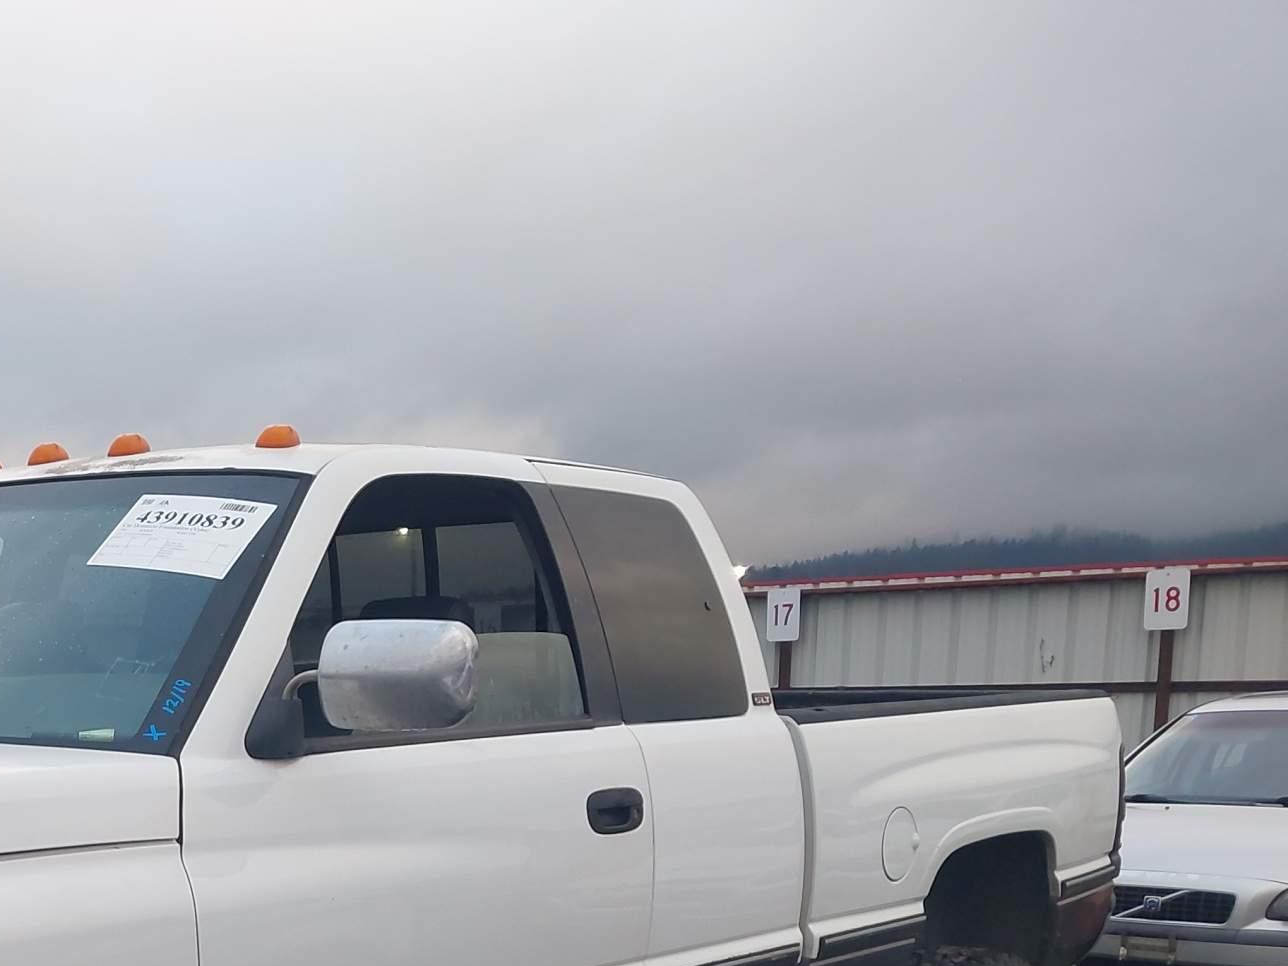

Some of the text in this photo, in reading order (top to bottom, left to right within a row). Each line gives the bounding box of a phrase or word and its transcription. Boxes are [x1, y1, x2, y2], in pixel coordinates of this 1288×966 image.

[135, 510, 245, 531] 43910839
[1153, 586, 1181, 613] 18
[773, 604, 794, 626] 17
[161, 679, 192, 715] 12/19
